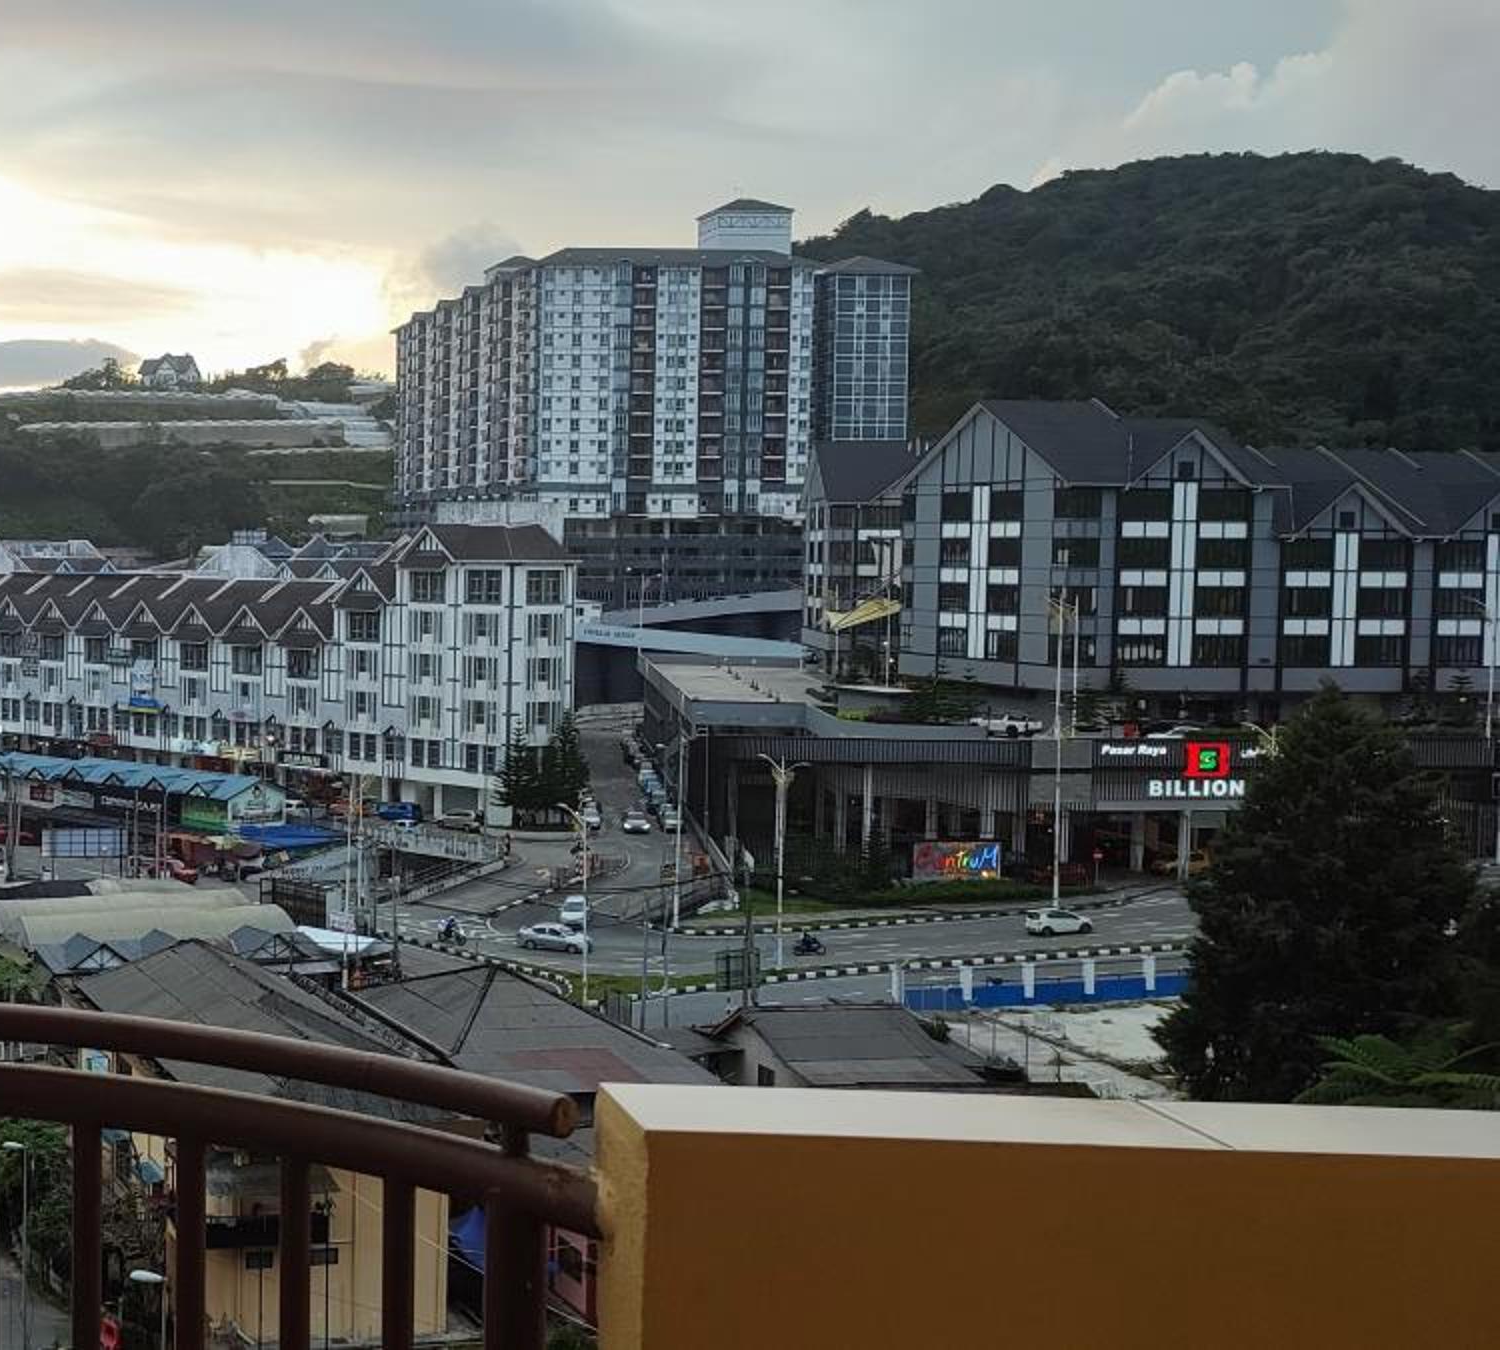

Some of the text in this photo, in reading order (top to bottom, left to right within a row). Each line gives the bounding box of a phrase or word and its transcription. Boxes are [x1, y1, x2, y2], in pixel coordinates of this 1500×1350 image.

[1101, 744, 1167, 757] Pasar Raya
[1150, 780, 1245, 796] BILLION
